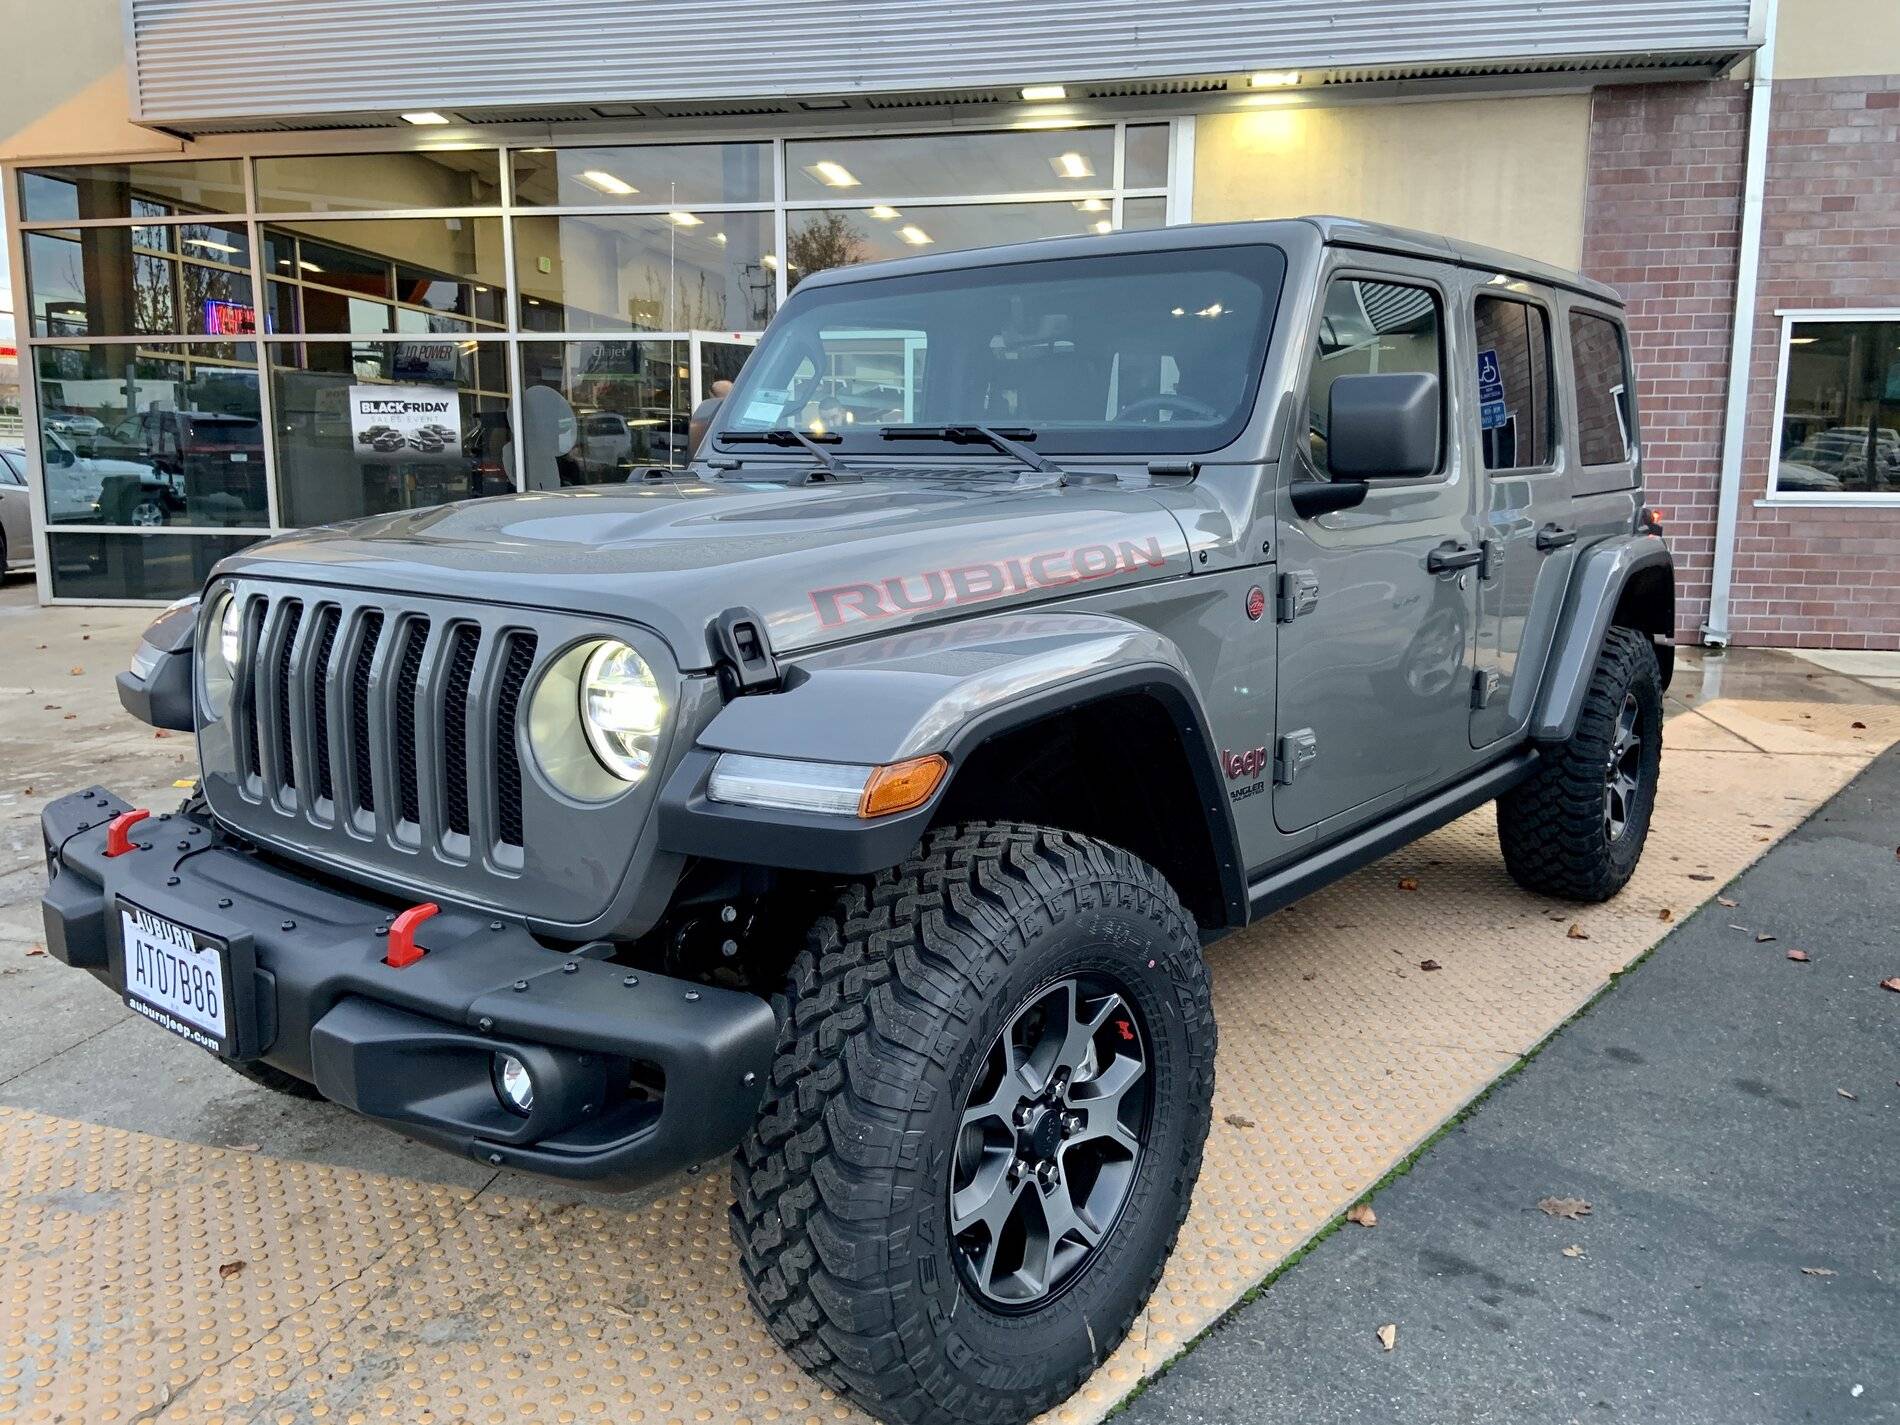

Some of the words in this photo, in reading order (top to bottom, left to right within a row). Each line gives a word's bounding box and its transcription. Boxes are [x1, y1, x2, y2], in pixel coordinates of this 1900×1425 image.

[419, 345, 453, 359] POWER
[360, 401, 404, 414] BLACK
[405, 402, 450, 413] FRIDAY
[407, 415, 440, 424] EVENT
[808, 536, 1165, 628] RUBICON
[1222, 746, 1268, 780] Jeep
[1230, 781, 1265, 799] ANGLER
[136, 910, 196, 953] AUBURN
[129, 998, 220, 1051] auburnjeep.com
